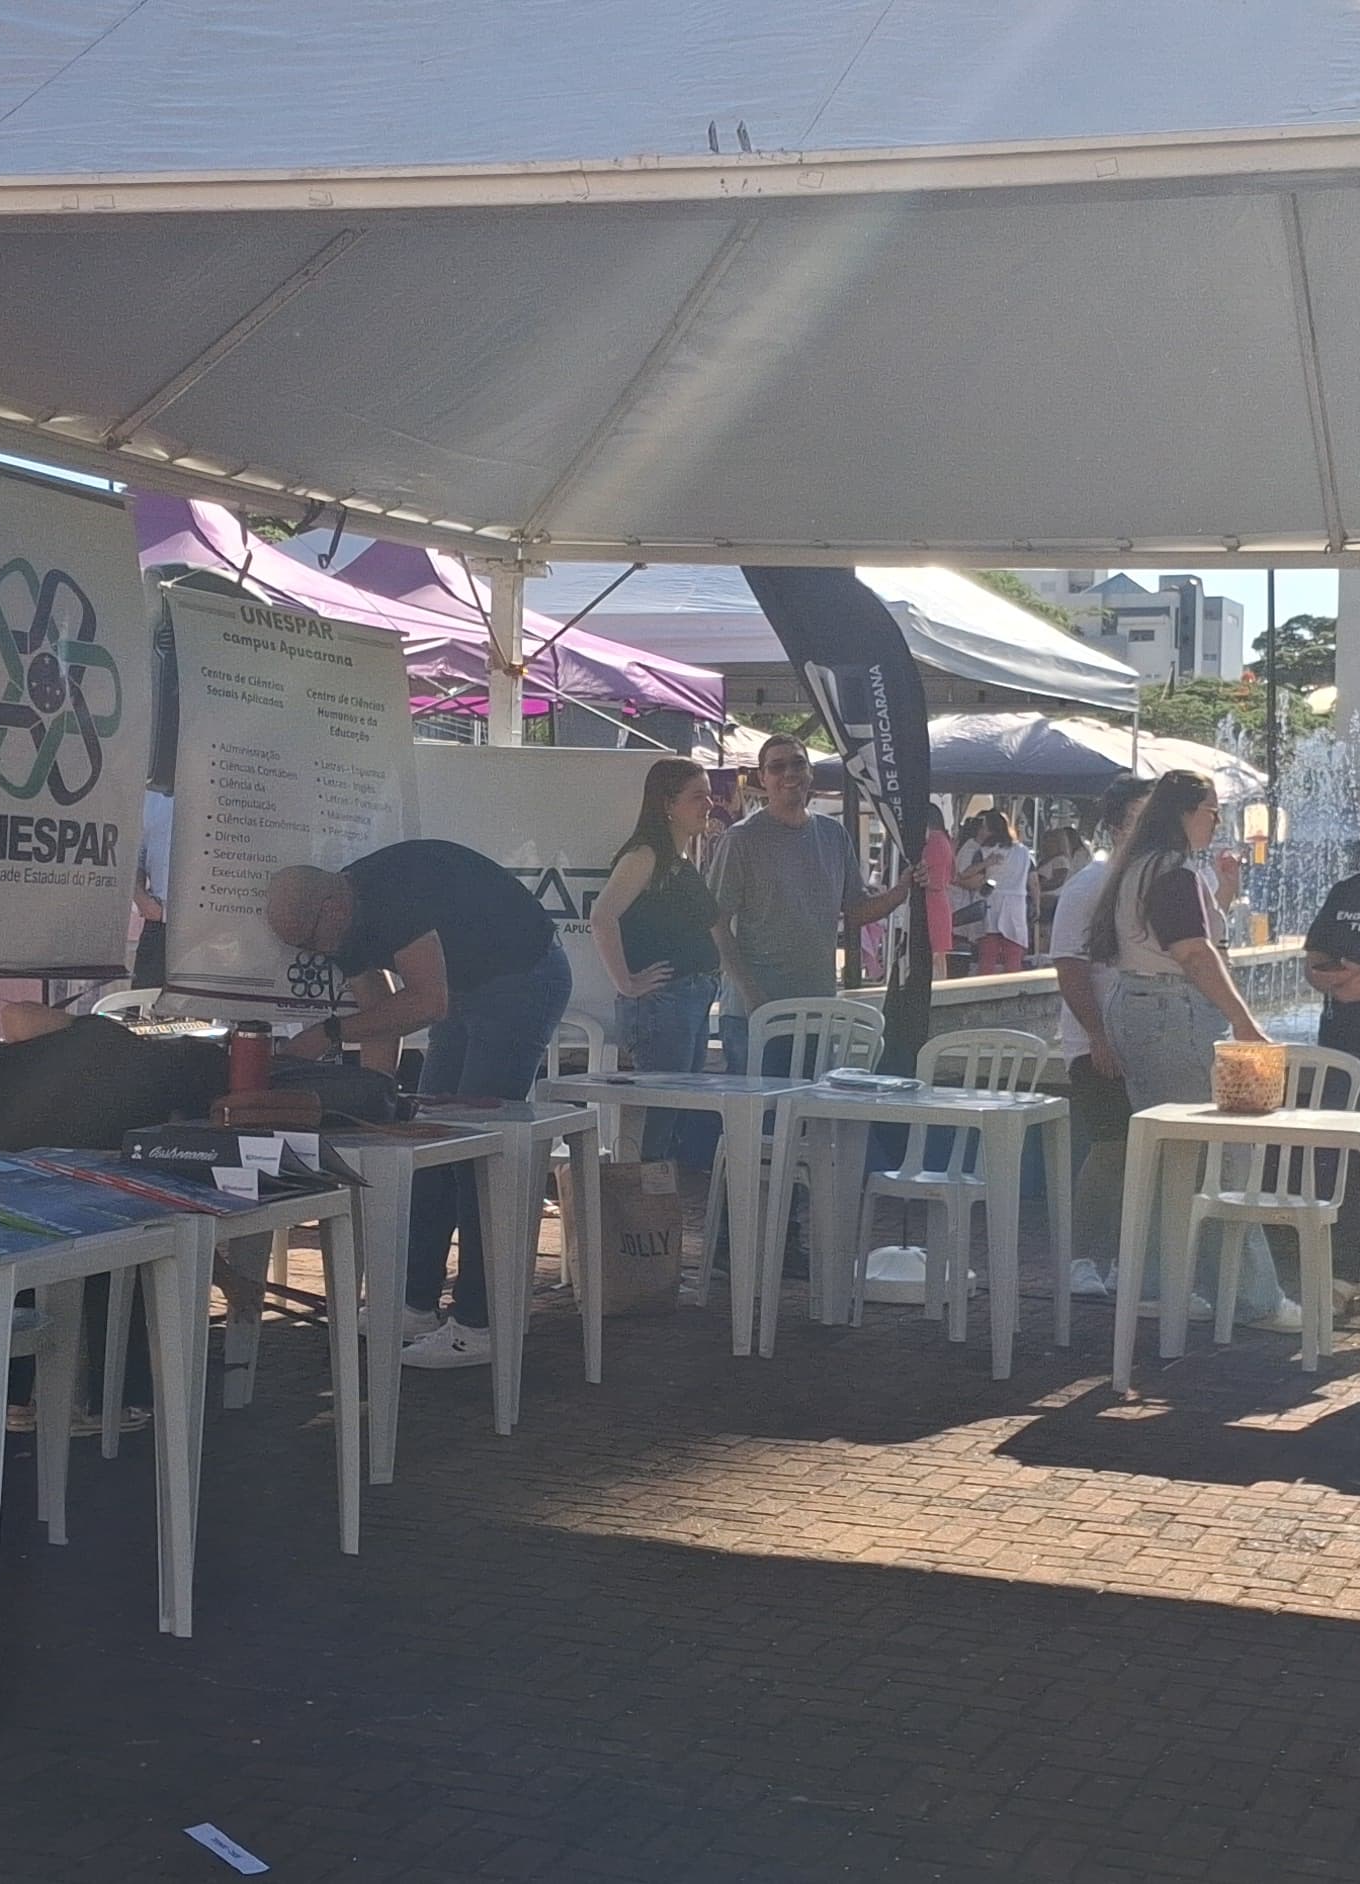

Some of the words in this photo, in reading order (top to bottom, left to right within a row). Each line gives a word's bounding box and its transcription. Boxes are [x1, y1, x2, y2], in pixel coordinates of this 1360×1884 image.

[240, 606, 334, 640] UNESPAR
[223, 631, 276, 653] campus
[280, 639, 353, 668] Apucarana
[200, 666, 232, 682] Centro
[234, 675, 245, 685] de
[206, 684, 239, 701] Sociais
[241, 690, 284, 709] Aplicadas
[306, 688, 336, 704] Centro
[338, 694, 349, 705] de
[869, 664, 897, 764] APUCARANA
[219, 777, 252, 791] Ciência
[886, 769, 900, 791] DE
[216, 813, 258, 827] Ciências
[215, 831, 251, 844] Direito
[213, 849, 278, 864] Secretariado
[24, 867, 69, 886] Estadual
[72, 872, 85, 886] do
[210, 884, 249, 902] Serviço
[619, 1229, 671, 1258] JOLLY
